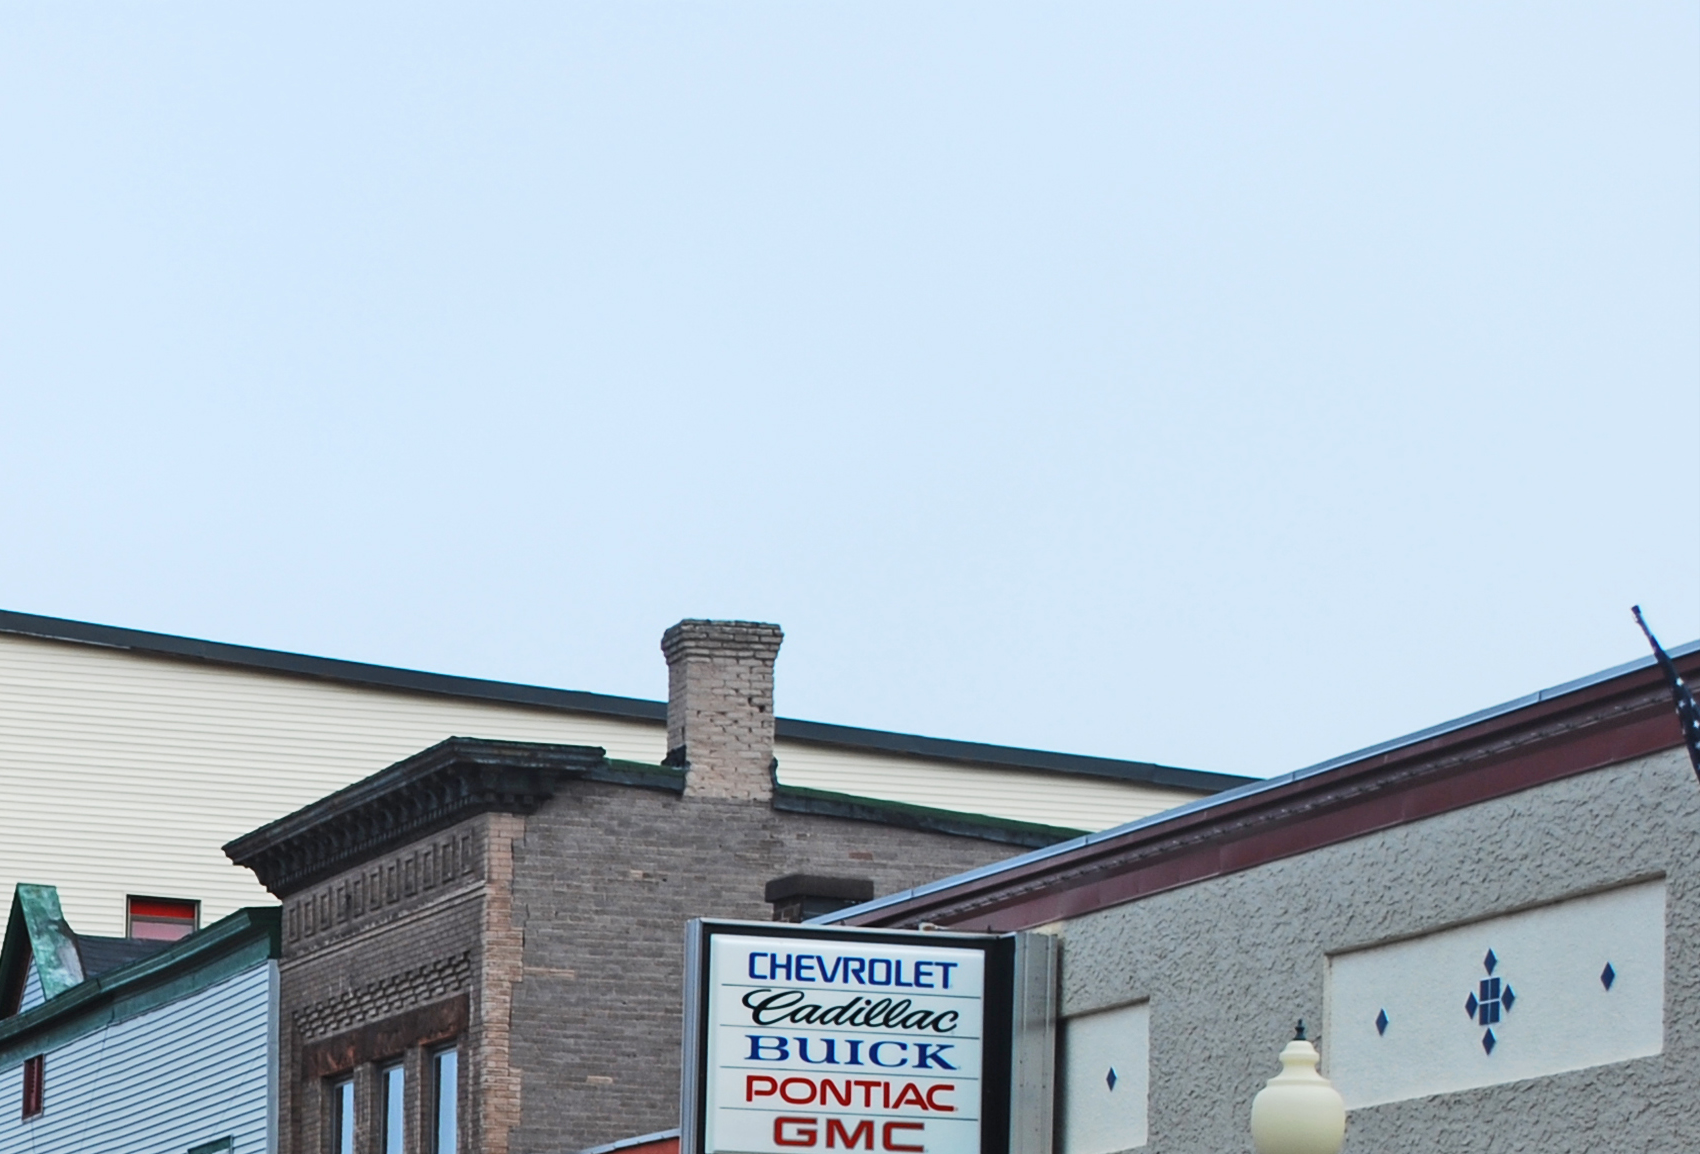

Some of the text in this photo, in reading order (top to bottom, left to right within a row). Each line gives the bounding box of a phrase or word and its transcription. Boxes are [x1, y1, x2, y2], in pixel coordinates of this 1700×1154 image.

[748, 951, 958, 990] CHEVROLET
[741, 988, 960, 1034] Cadillac
[744, 1034, 958, 1071] BUICK
[746, 1075, 956, 1112] PONTIAC
[773, 1116, 926, 1154] GMC
